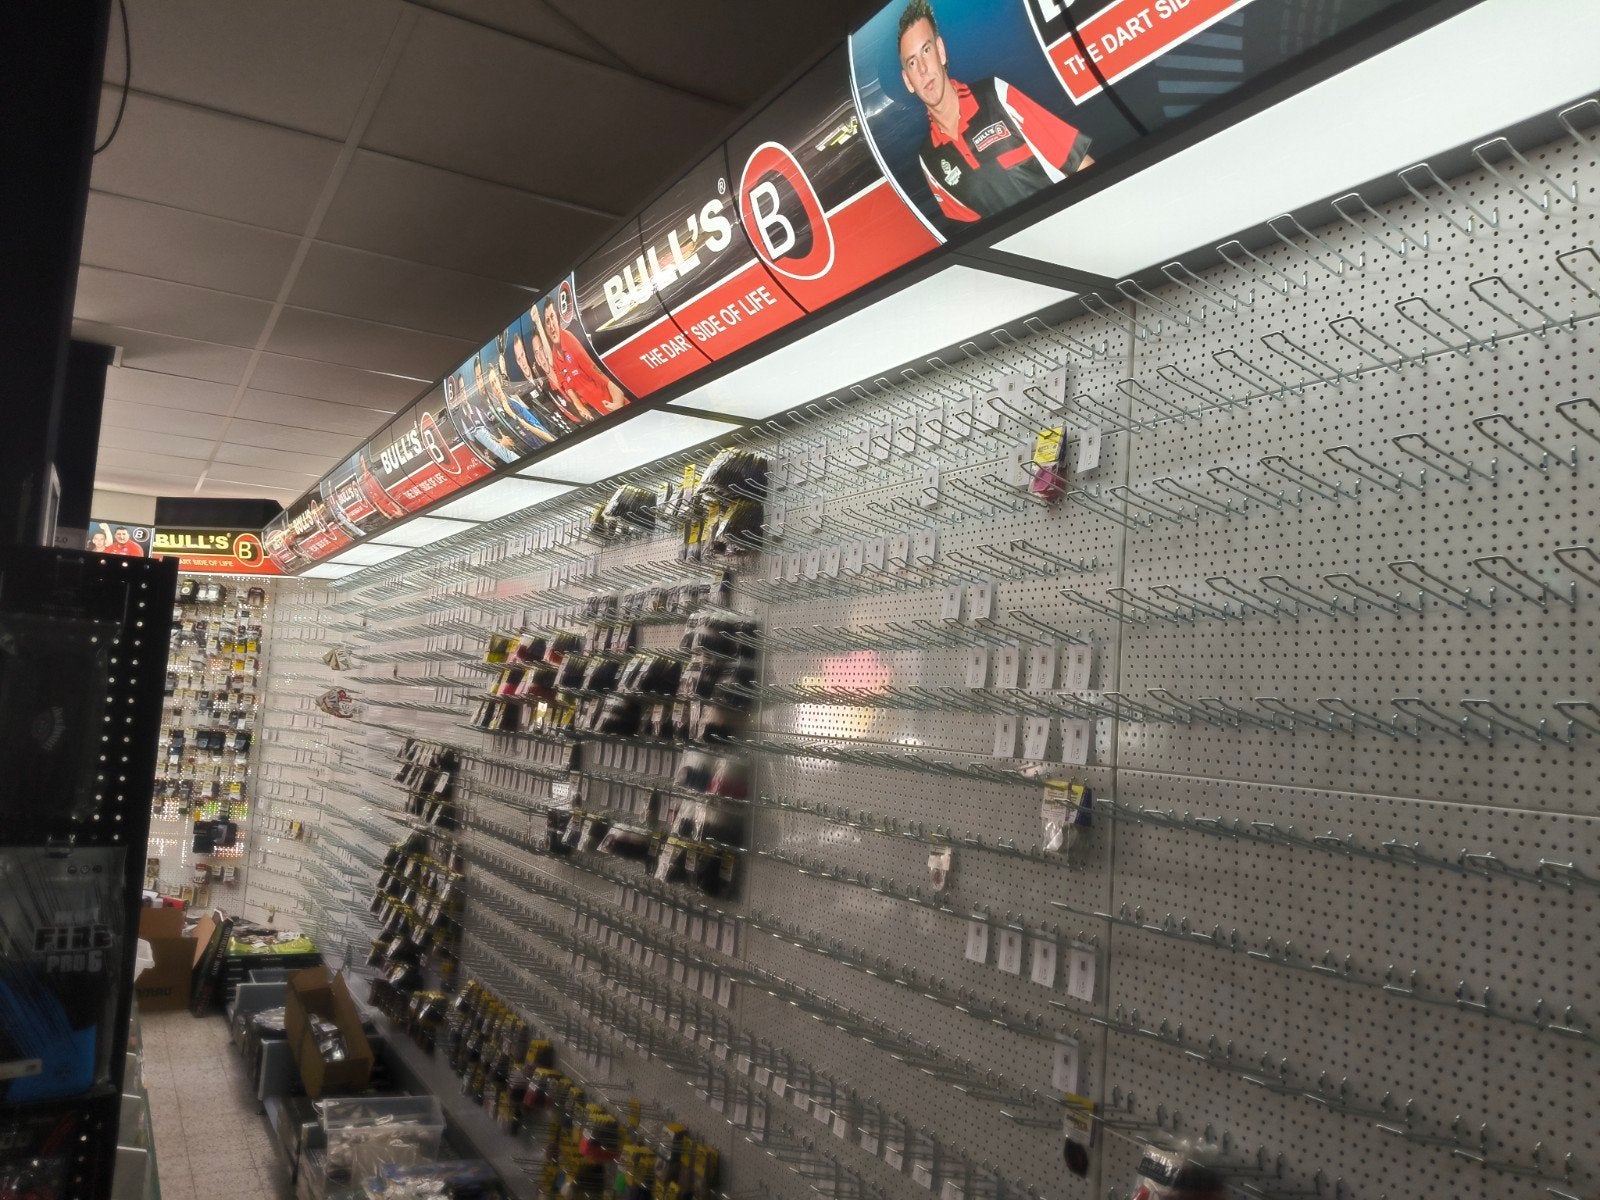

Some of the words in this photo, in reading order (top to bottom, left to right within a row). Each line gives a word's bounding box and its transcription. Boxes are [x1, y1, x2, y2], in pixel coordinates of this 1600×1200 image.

[1101, 8, 1153, 54] DART
[1154, 0, 1191, 19] SID
[603, 198, 732, 321] BULL'S
[749, 180, 796, 261] B
[639, 346, 669, 369] THE
[690, 314, 727, 343] SIDE
[719, 303, 742, 326] OF
[738, 285, 778, 317] LIFE
[380, 428, 423, 475] BULL'S
[153, 534, 229, 549] BULL'S
[238, 541, 251, 559] B
